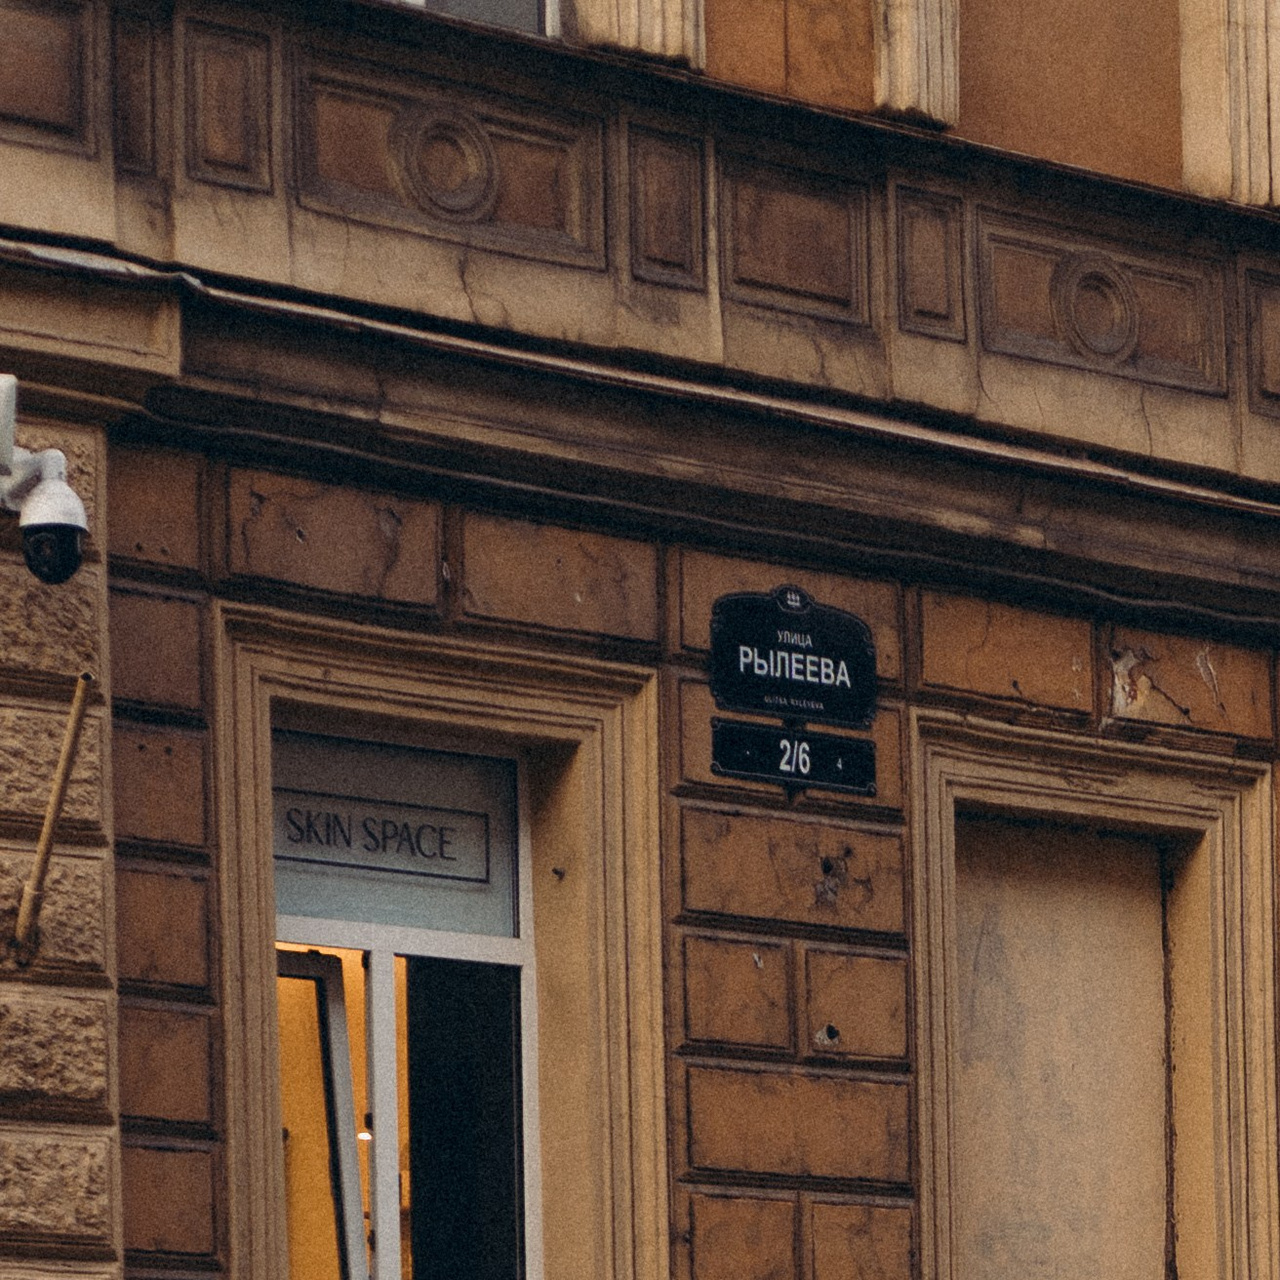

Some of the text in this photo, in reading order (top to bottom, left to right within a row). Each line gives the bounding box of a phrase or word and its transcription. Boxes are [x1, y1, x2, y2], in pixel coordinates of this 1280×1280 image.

[777, 630, 813, 648] УЛИЦА
[739, 645, 851, 688] РЫЛЕЕВА
[779, 739, 811, 774] 2/6
[286, 807, 457, 862] SKIN SPACE
